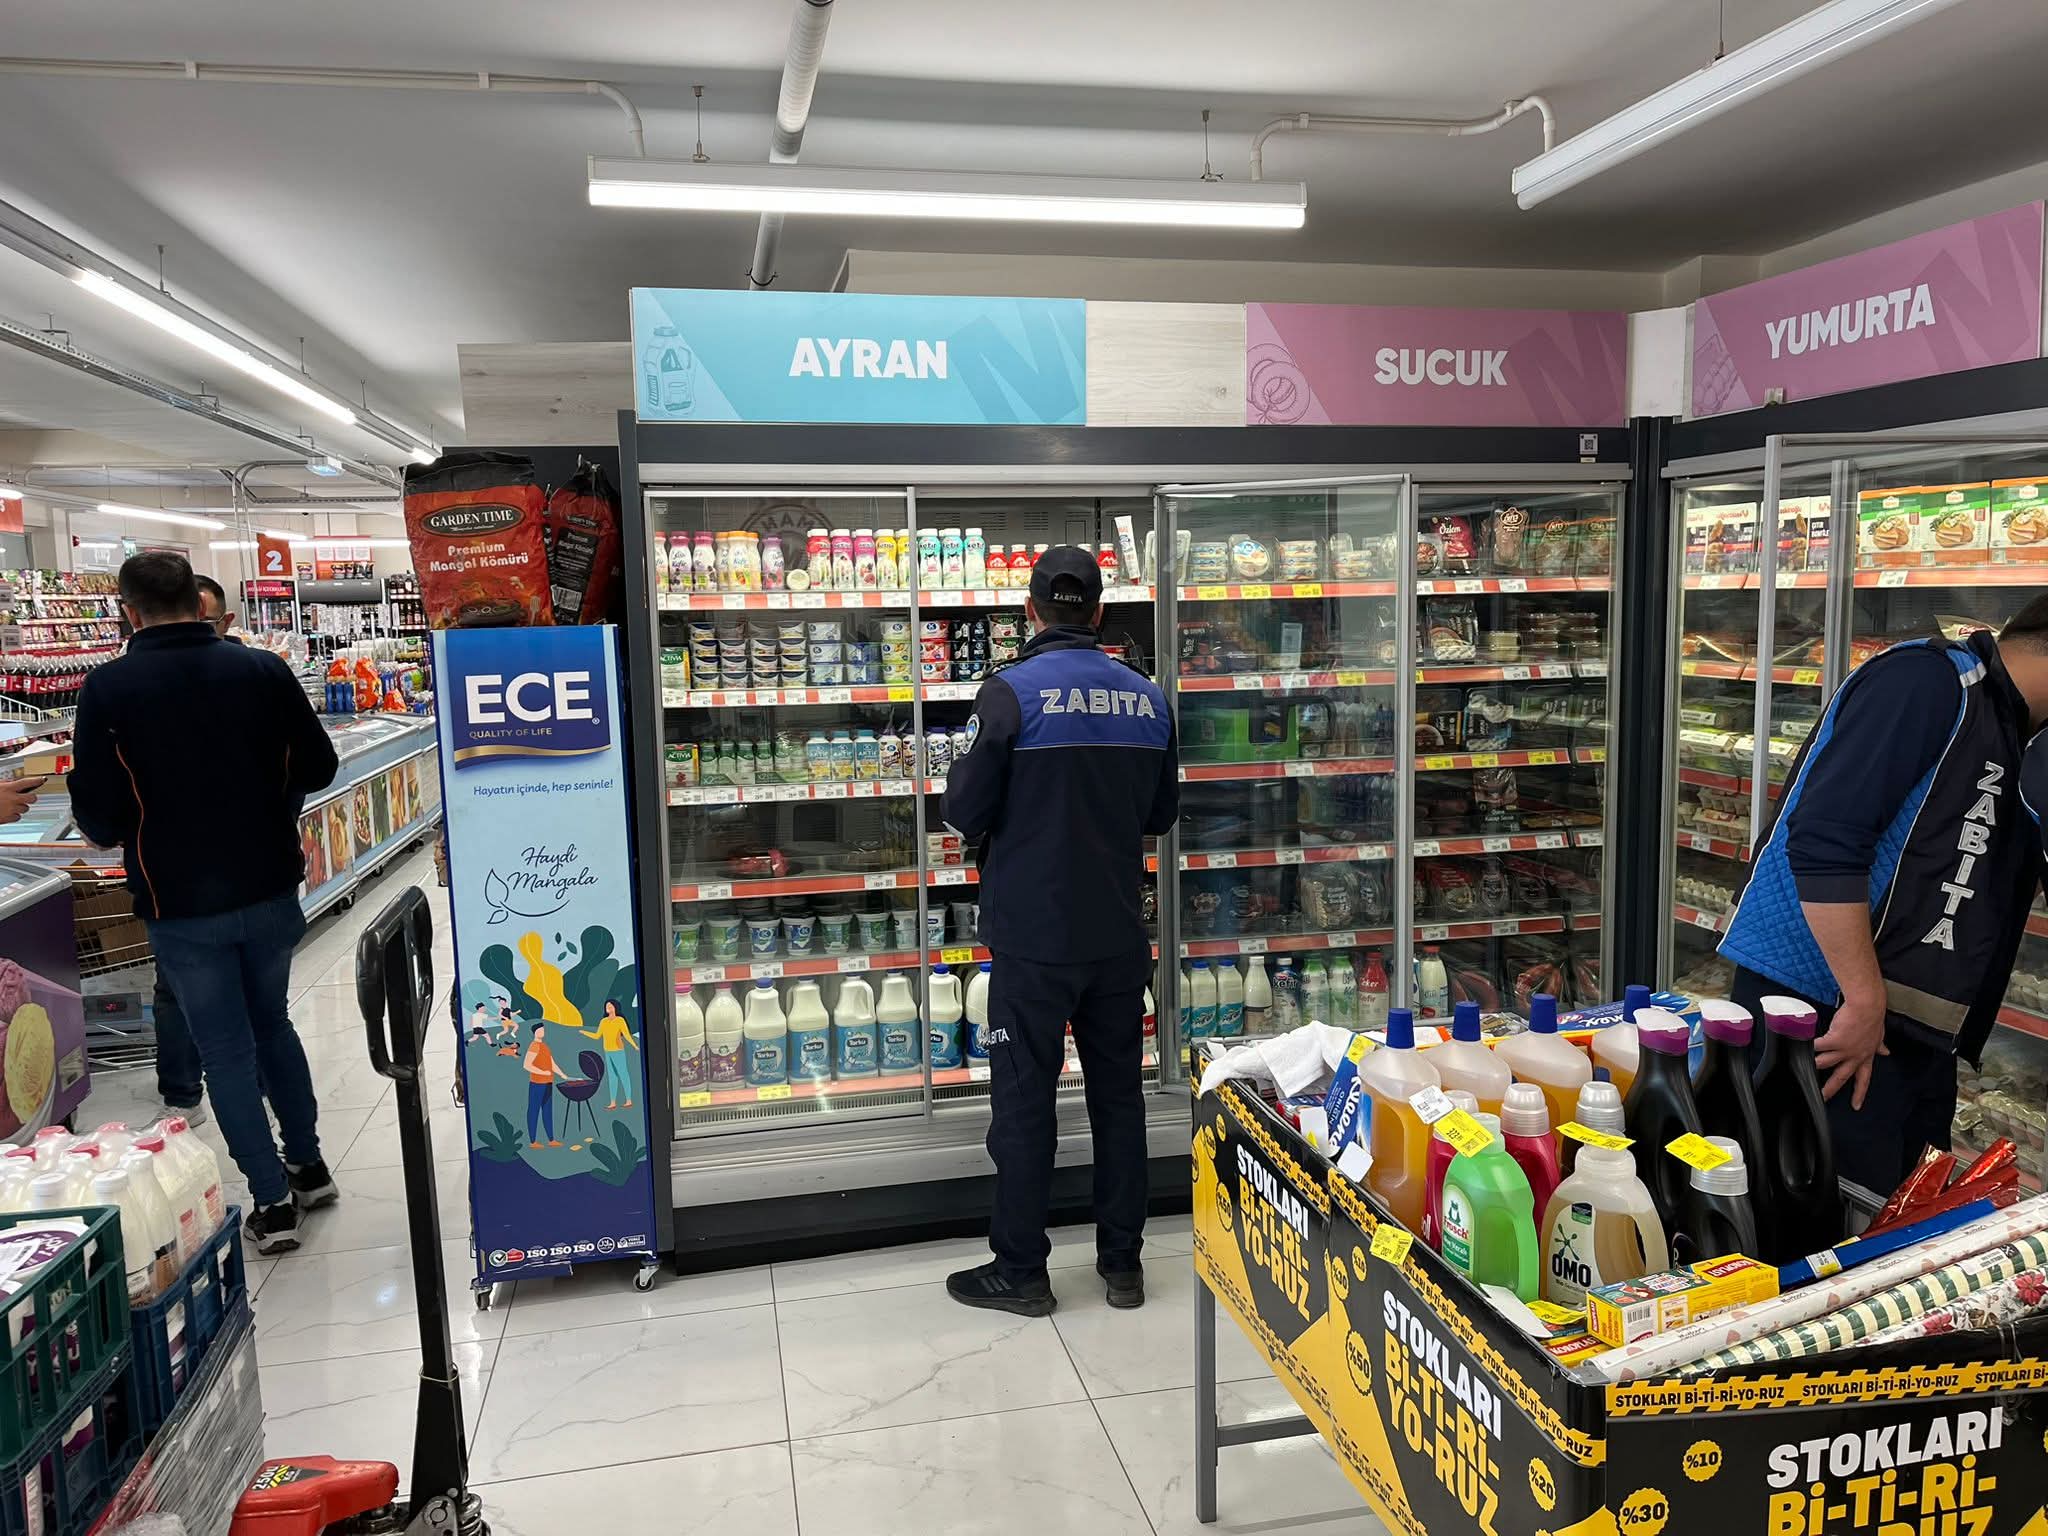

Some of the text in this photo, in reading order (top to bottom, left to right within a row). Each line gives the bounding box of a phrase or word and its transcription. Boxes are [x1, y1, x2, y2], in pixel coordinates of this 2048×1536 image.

[1764, 283, 1937, 360] YUMURTA
[788, 337, 947, 379] AYRAN
[1374, 348, 1509, 386] SUCUK
[430, 509, 514, 527] GARDEN TIME
[265, 550, 284, 571] 2
[430, 552, 529, 572] Mangal Kömürü
[447, 542, 505, 556] Premium
[1053, 592, 1083, 602] ZABITA
[465, 671, 592, 724] ECE
[1040, 688, 1156, 718] ZABITA
[469, 726, 553, 740] QUALITY OF LIFE
[473, 779, 614, 798] Hayatın içinde, hep seninle!
[521, 843, 578, 876] Haydi
[1921, 761, 2004, 951] ZABITA
[507, 867, 599, 900] Mangala
[1237, 1143, 1309, 1240] STOKLARI
[526, 1249, 548, 1259] ISO
[550, 1246, 572, 1256] ISO
[573, 1242, 595, 1253] ISO
[1241, 1210, 1310, 1322] YO-RUZ
[1552, 1253, 1592, 1287] OMO
[1348, 1341, 1371, 1380] %50
[1384, 1289, 1502, 1442] STOKLARI
[1482, 1348, 1518, 1395] STOKLARI
[1976, 1367, 2033, 1385] STOKLARI
[1615, 1391, 1682, 1408] STOKLARI
[1802, 1380, 1864, 1397] STOKLARI
[1387, 1375, 1499, 1536] YO-RUZ
[1686, 1452, 1719, 1468] %10
[1766, 1407, 2003, 1489] STOKLARI
[1530, 1467, 1555, 1501] %20
[1623, 1502, 1666, 1525] %30
